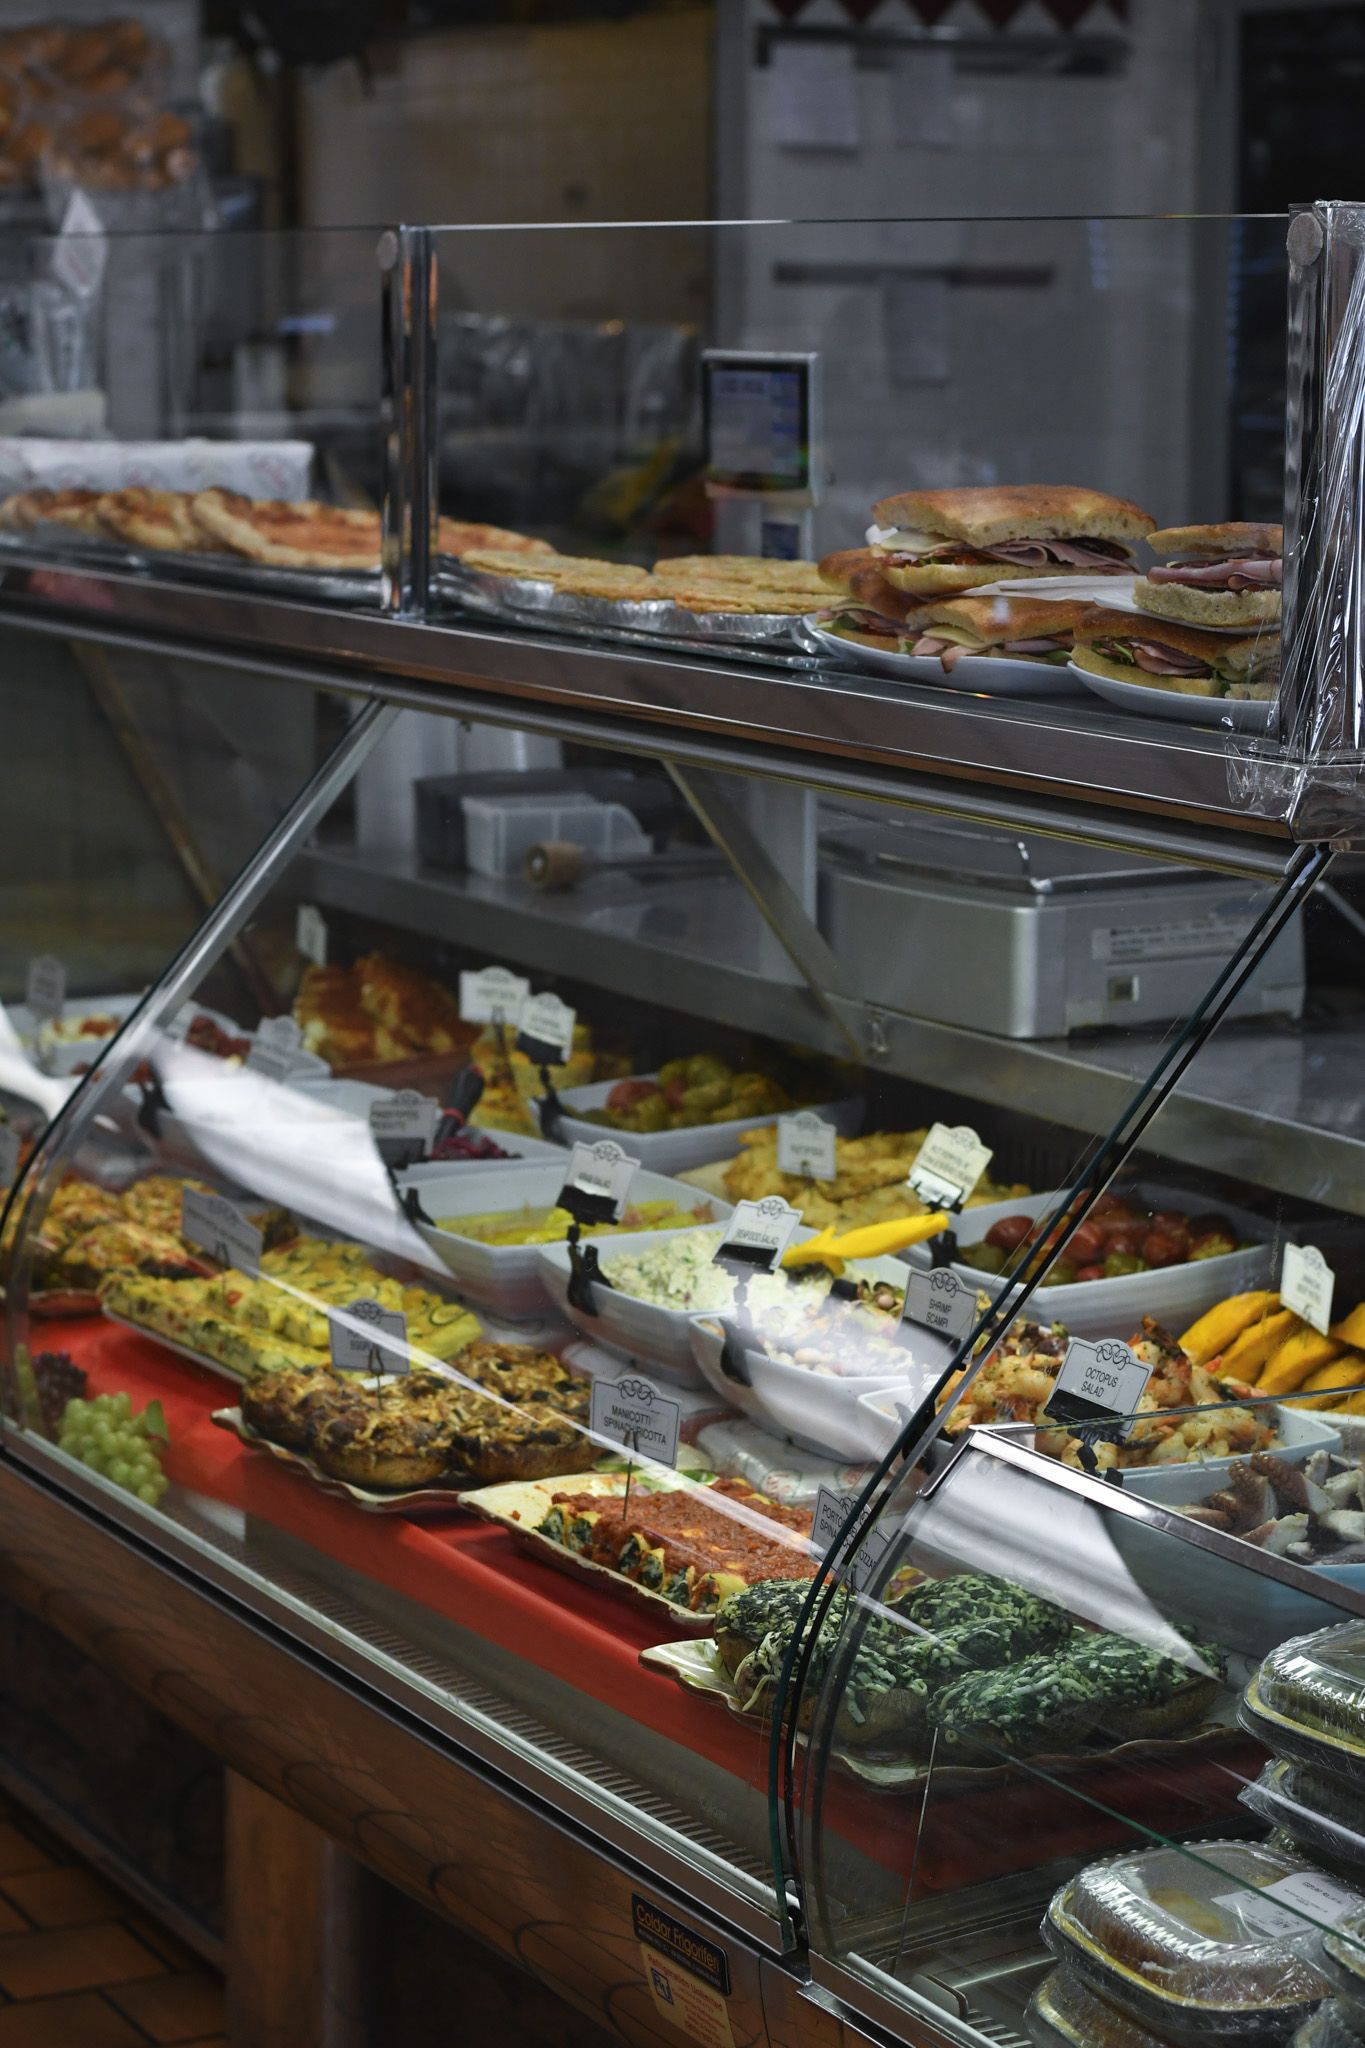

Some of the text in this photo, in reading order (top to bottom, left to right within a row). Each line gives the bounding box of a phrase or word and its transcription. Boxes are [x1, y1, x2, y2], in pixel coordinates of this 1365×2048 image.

[929, 1298, 952, 1314] SHRIMP
[926, 1312, 949, 1328] SCAMPI
[1085, 1367, 1119, 1388] OCTOPUS
[1081, 1381, 1105, 1398] SALAD
[611, 1404, 652, 1425] MANICOTTI
